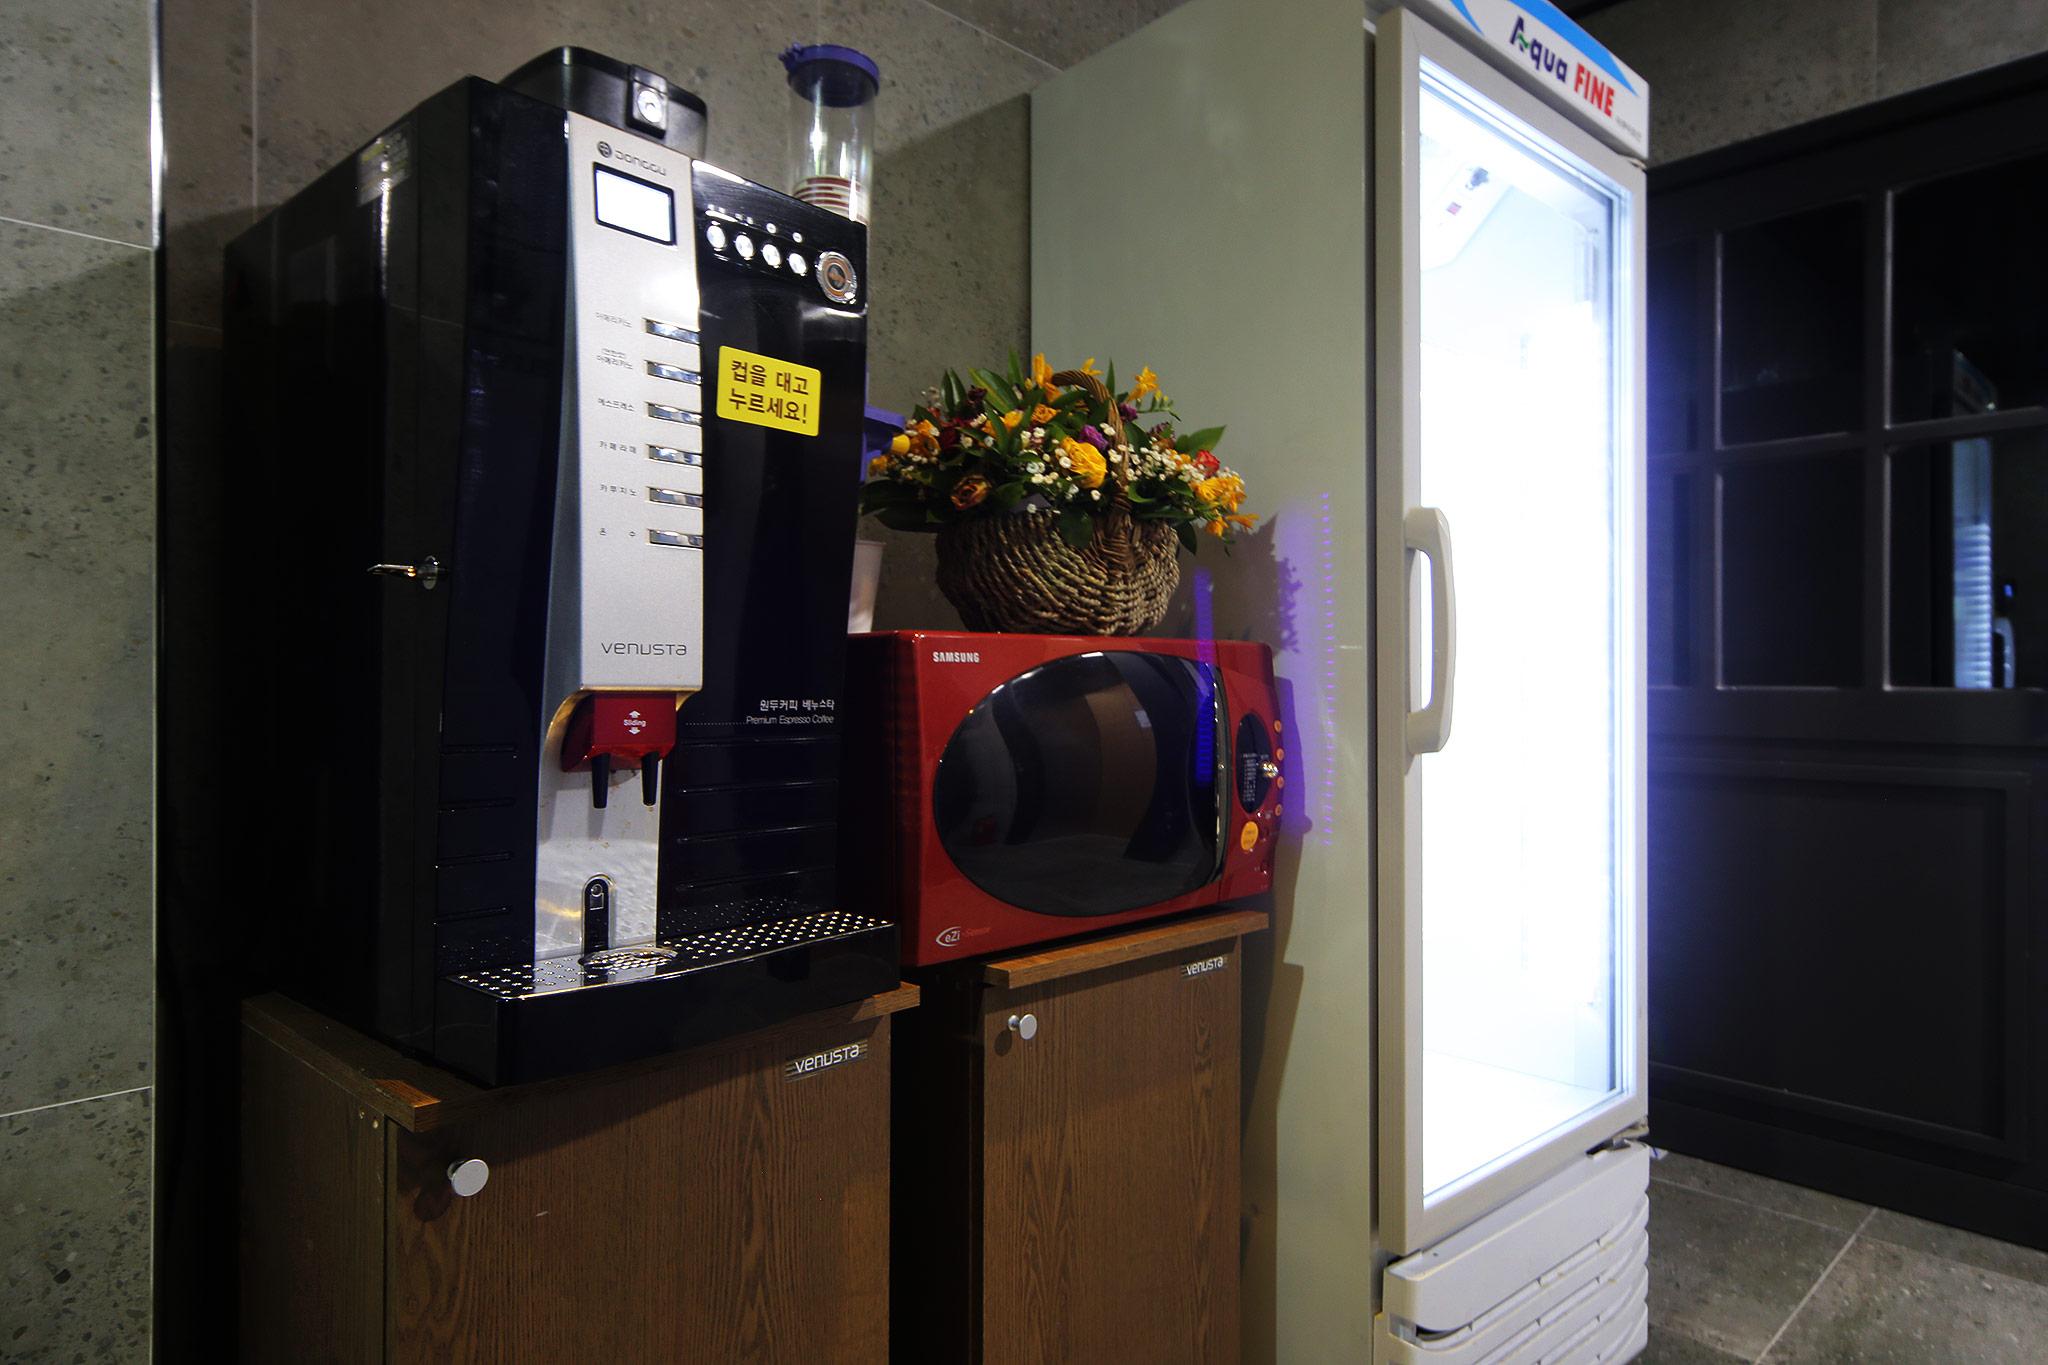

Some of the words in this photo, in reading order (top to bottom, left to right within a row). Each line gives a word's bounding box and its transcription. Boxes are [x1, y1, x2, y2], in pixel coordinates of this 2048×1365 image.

[1509, 15, 1568, 83] Aqua
[1574, 62, 1615, 118] FINE
[731, 360, 767, 387] 컵을
[776, 372, 809, 395] 대고
[729, 388, 807, 424] 누르세요!
[932, 651, 980, 663] SAMSUNG
[760, 699, 799, 711] 원두커피
[802, 699, 835, 711] 베누스타
[746, 715, 777, 724] Premium
[779, 714, 811, 724] Espresso
[812, 714, 835, 724] Coffee
